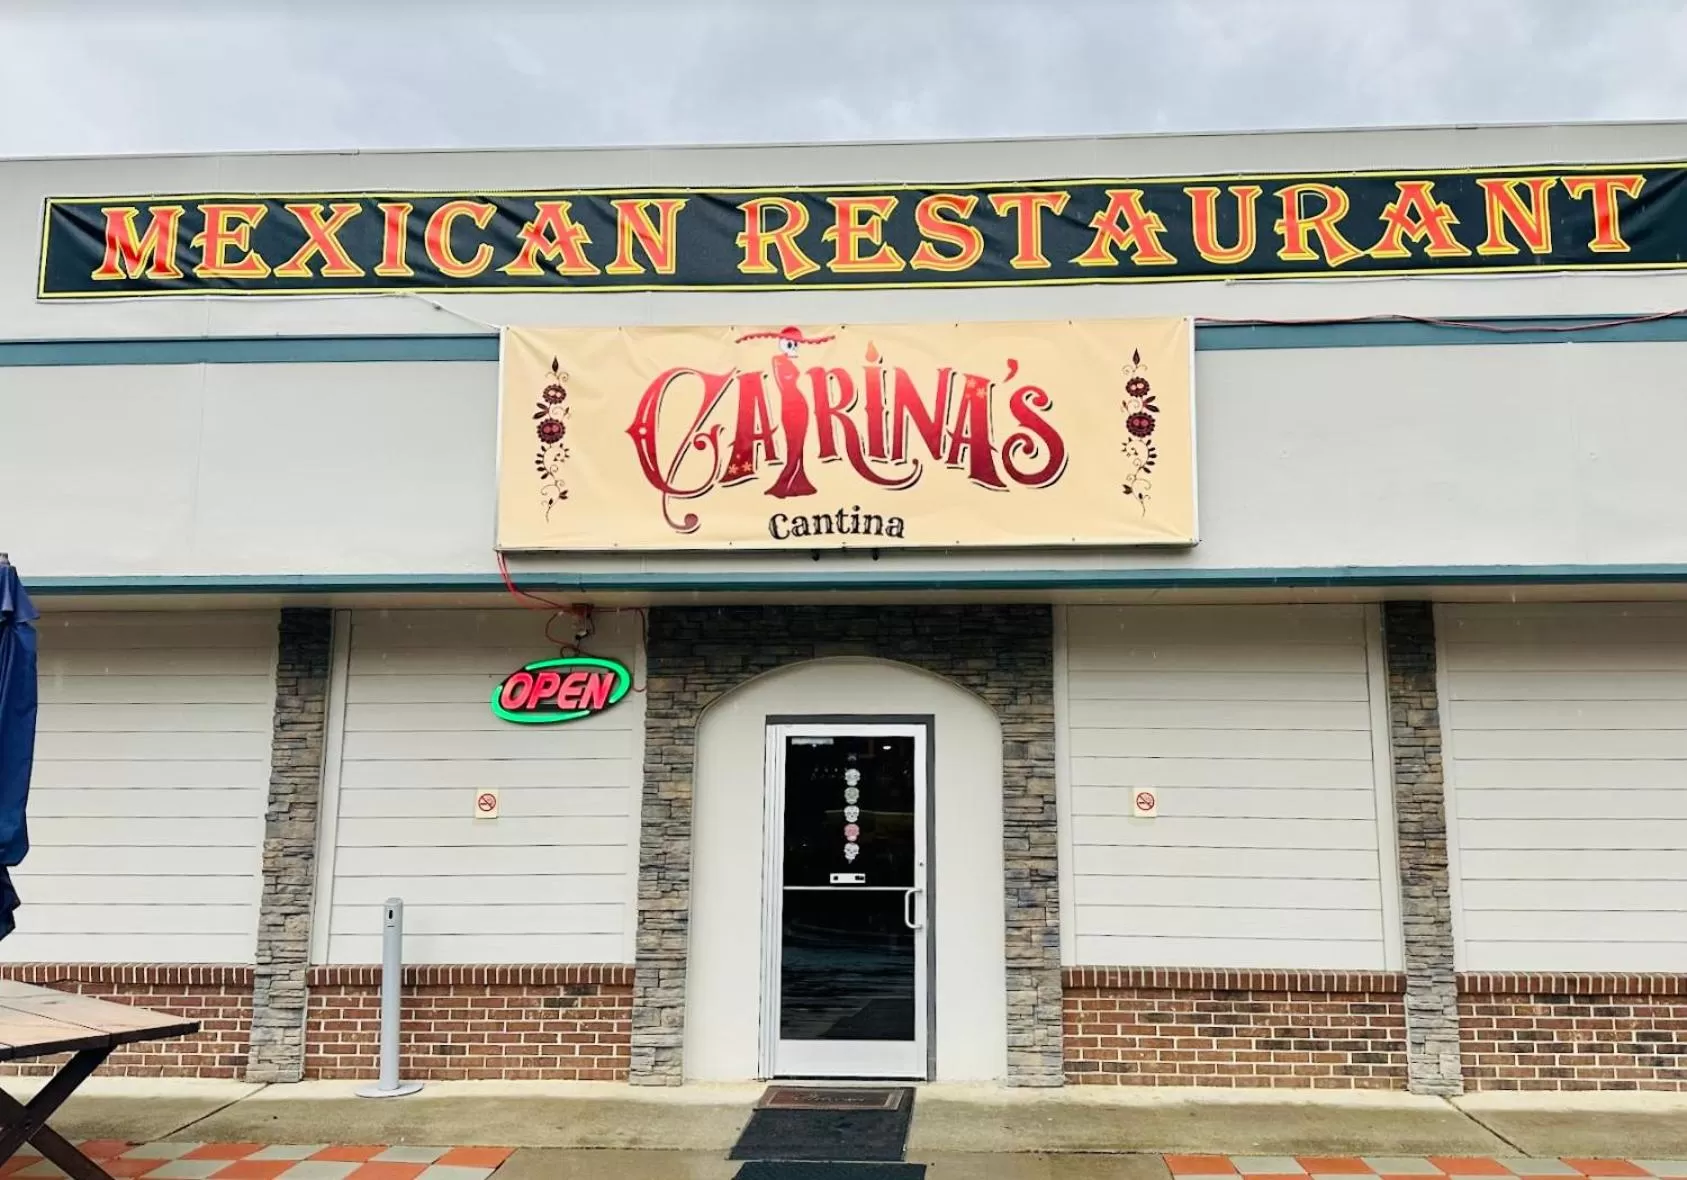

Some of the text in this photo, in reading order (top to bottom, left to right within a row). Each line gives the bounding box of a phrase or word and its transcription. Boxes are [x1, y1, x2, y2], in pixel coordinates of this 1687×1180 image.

[91, 173, 1649, 282] MEXICAN RESTAURANT
[768, 504, 905, 540] Cantina
[500, 671, 616, 710] OPEN
